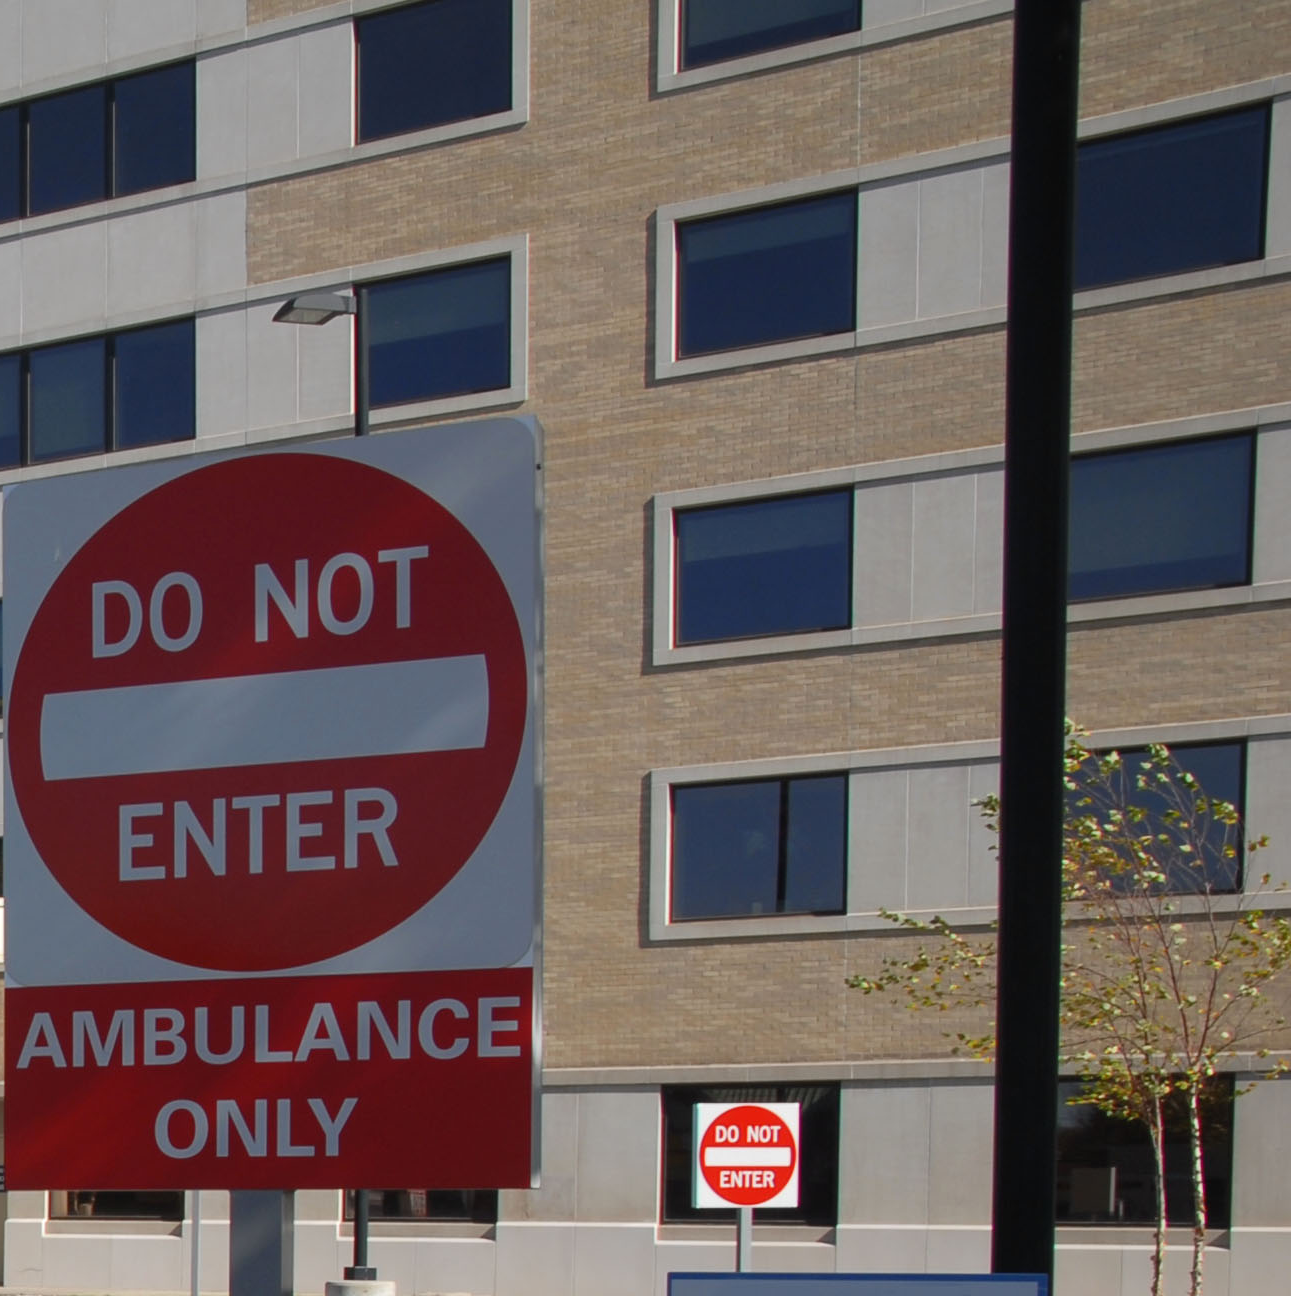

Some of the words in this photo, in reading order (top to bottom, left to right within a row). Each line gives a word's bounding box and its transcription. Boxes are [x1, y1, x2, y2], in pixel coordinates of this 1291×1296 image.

[91, 571, 204, 659] DO
[254, 546, 429, 642] NOT
[118, 787, 399, 882] ENTER
[16, 996, 522, 1070] AMBULANCE
[154, 1097, 358, 1159] ONLY
[715, 1125, 739, 1143] DO
[746, 1125, 781, 1143] NOT
[719, 1171, 775, 1188] ENTER
